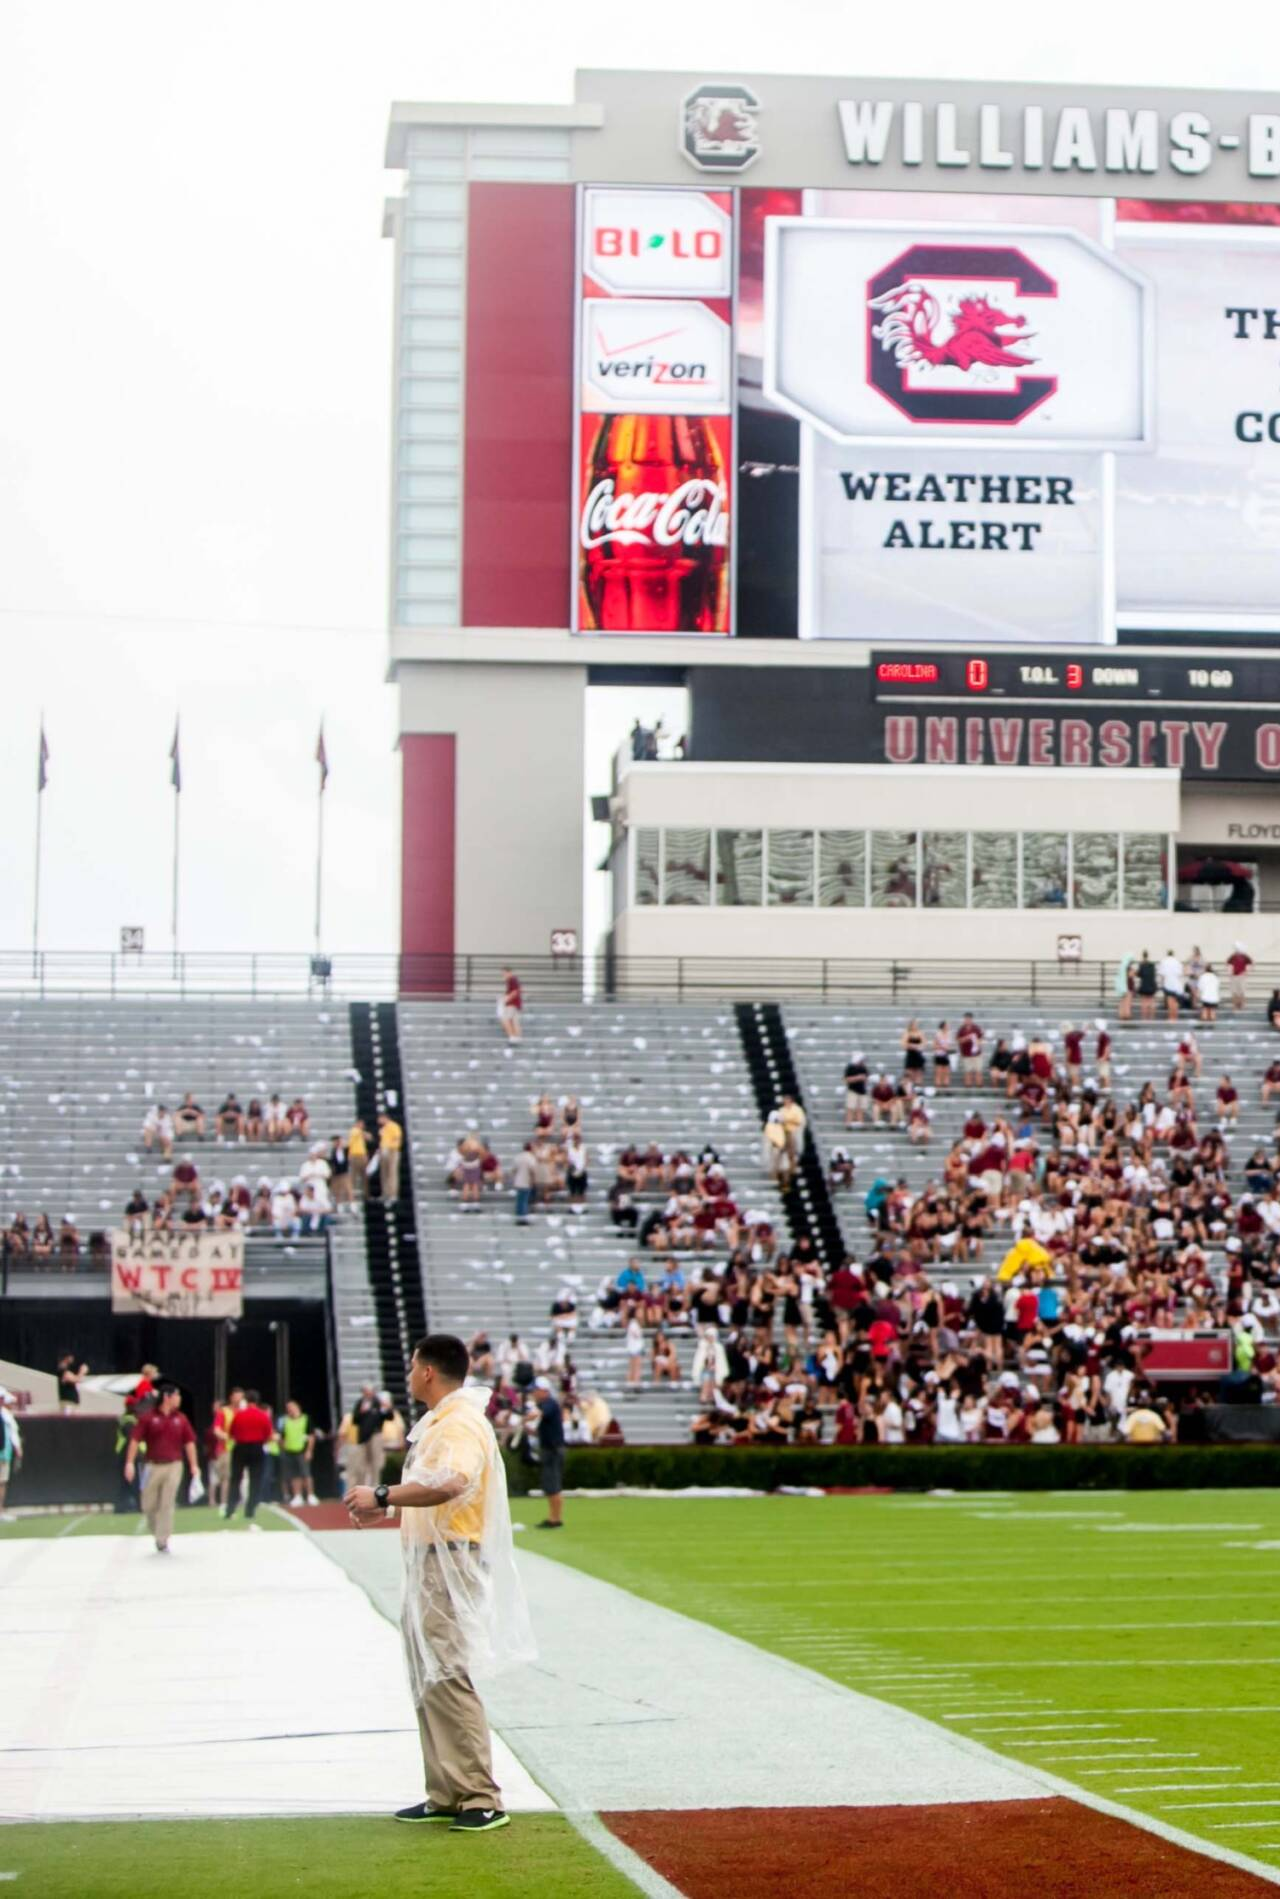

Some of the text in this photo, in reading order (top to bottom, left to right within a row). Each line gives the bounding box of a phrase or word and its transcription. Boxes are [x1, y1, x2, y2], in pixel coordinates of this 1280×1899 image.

[598, 358, 706, 386] verizon
[839, 472, 1075, 505] WEATHER
[580, 477, 728, 547] Coca-Cola
[883, 520, 1042, 551] ALERT
[877, 660, 988, 690] CAROLINA 0
[1066, 665, 1083, 690] 3
[1092, 667, 1139, 686] DOWN
[1188, 669, 1234, 688] TO GO
[884, 715, 1228, 770] UNIVERSITY
